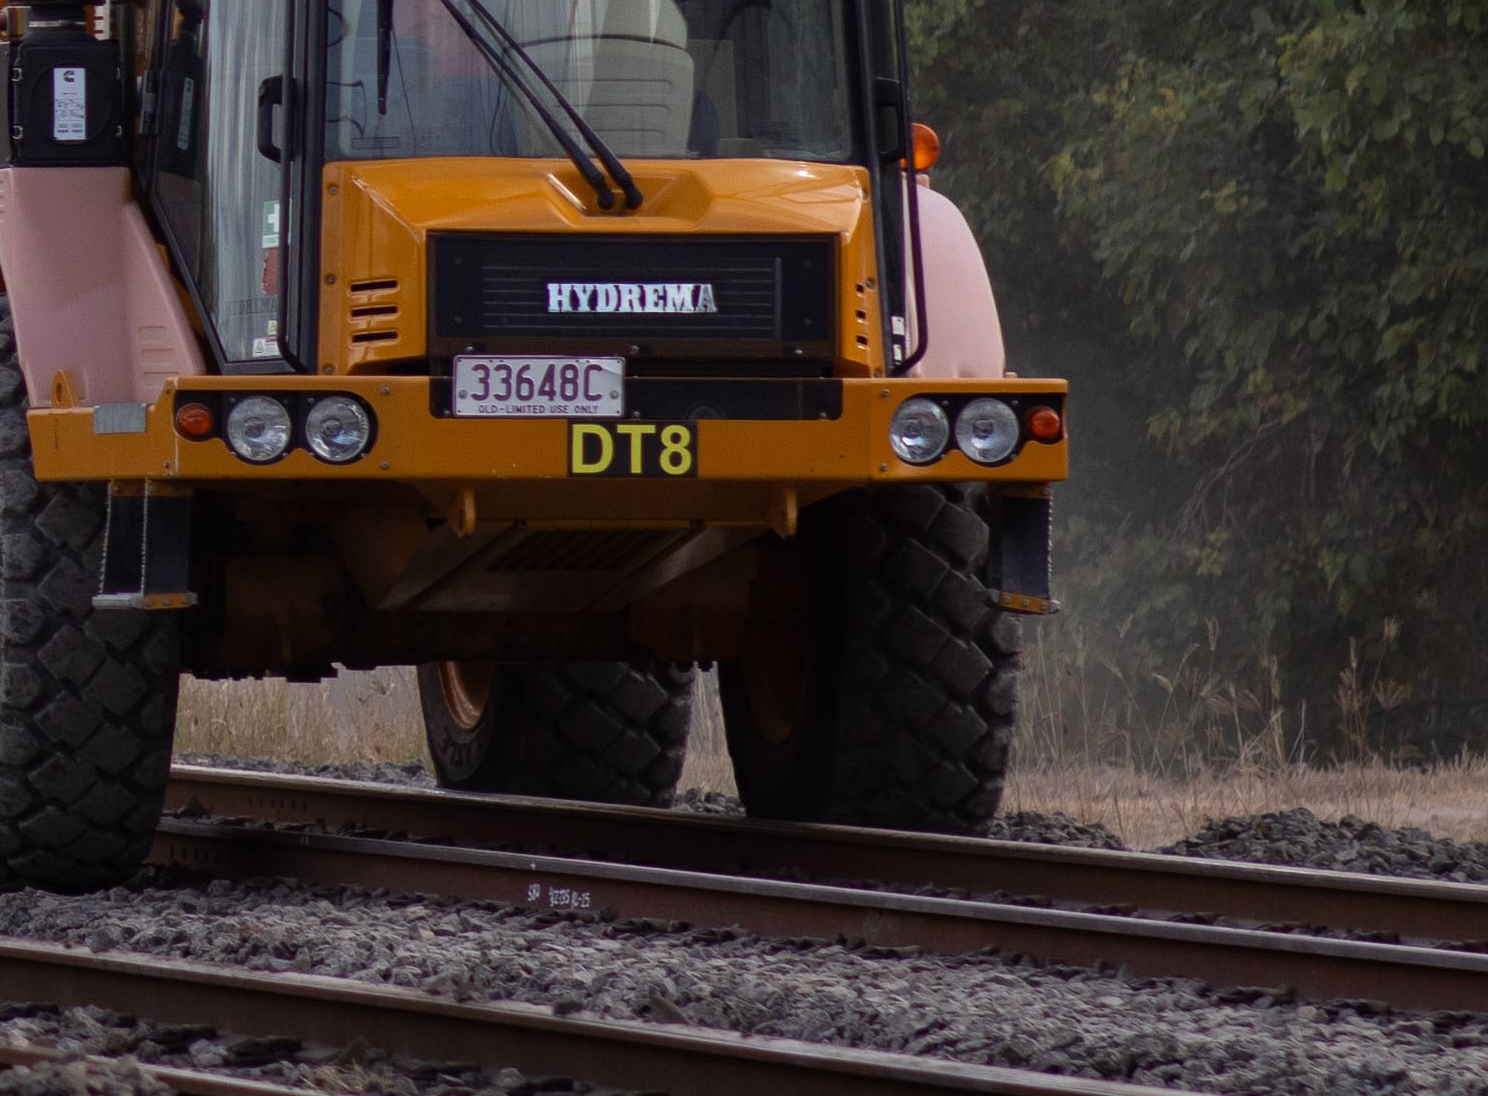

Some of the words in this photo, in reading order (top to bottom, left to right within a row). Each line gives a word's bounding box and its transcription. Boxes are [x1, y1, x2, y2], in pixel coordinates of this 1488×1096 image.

[547, 283, 718, 313] HYDREMA
[470, 363, 604, 402] 33648C
[549, 405, 570, 414] USE
[574, 405, 599, 414] ONLY
[572, 423, 693, 475] DT8
